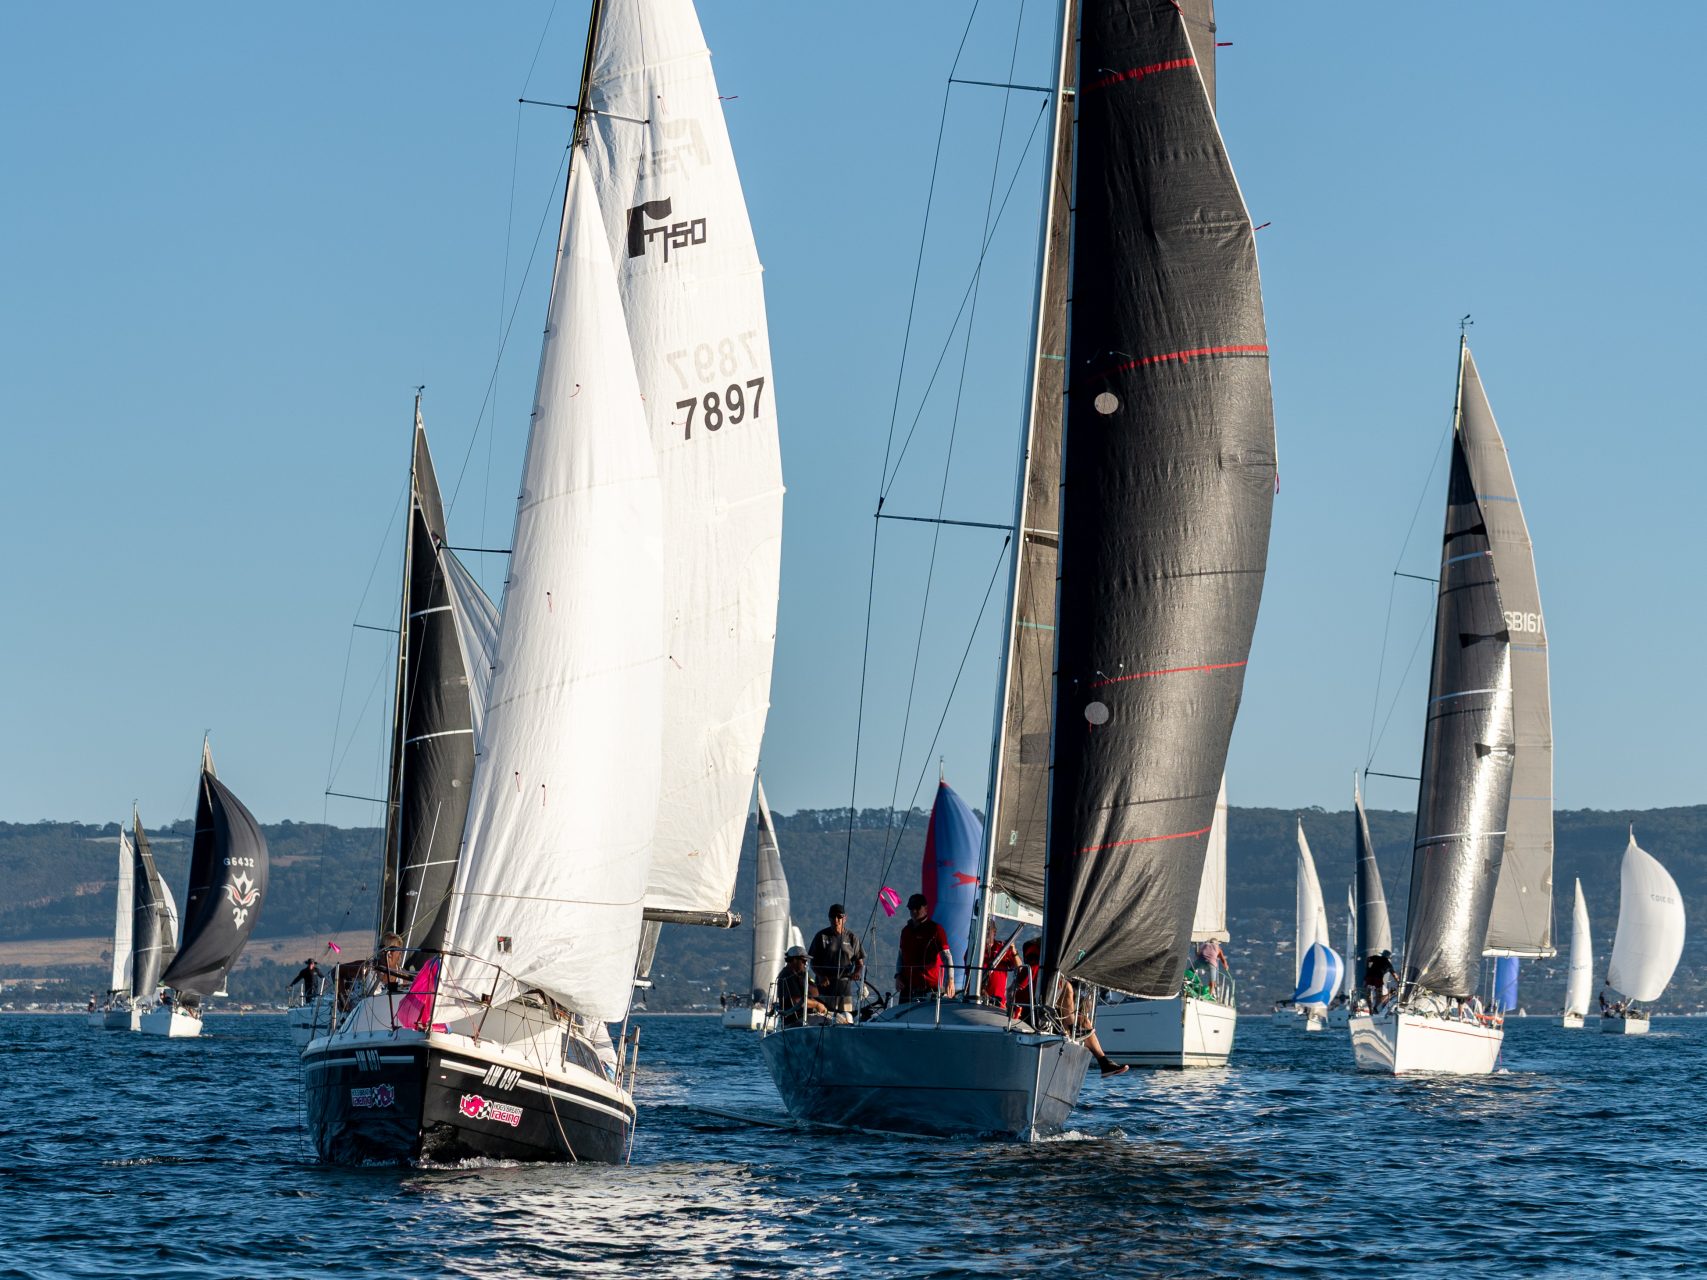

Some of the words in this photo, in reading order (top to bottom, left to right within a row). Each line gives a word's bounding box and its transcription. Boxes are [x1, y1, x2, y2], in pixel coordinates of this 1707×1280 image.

[676, 376, 766, 441] 7897
[1504, 611, 1543, 634] SB161
[482, 1064, 505, 1087] AW
[499, 1068, 522, 1092] 897
[491, 1110, 520, 1126] racing
